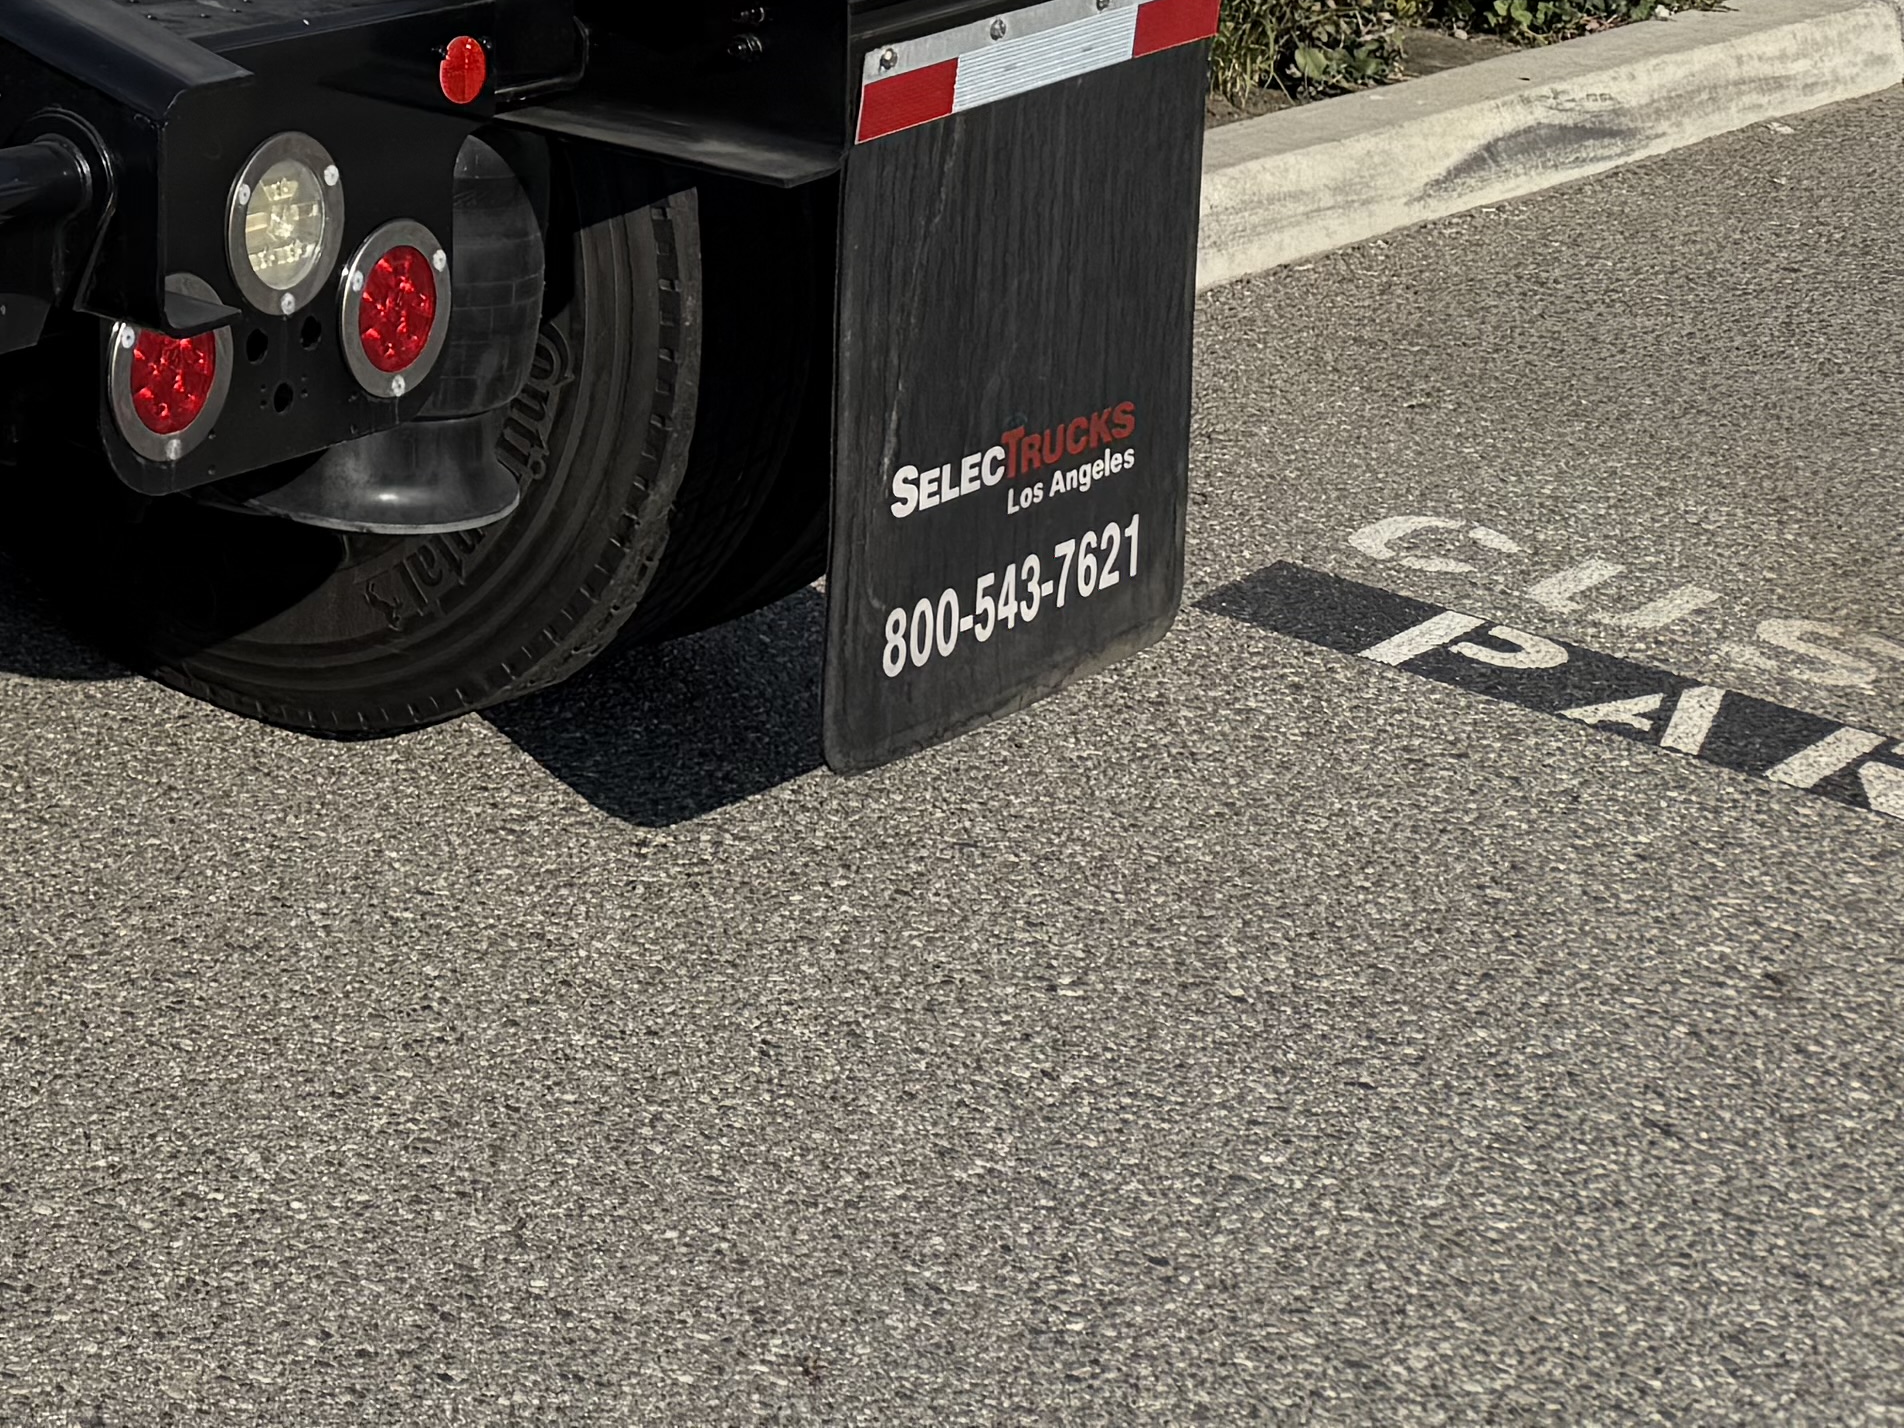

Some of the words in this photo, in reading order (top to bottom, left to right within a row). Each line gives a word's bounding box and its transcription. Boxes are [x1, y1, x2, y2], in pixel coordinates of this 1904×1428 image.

[1007, 482, 1043, 515] Los
[1049, 448, 1135, 496] Angeles
[882, 513, 1140, 677] 800-543-7621
